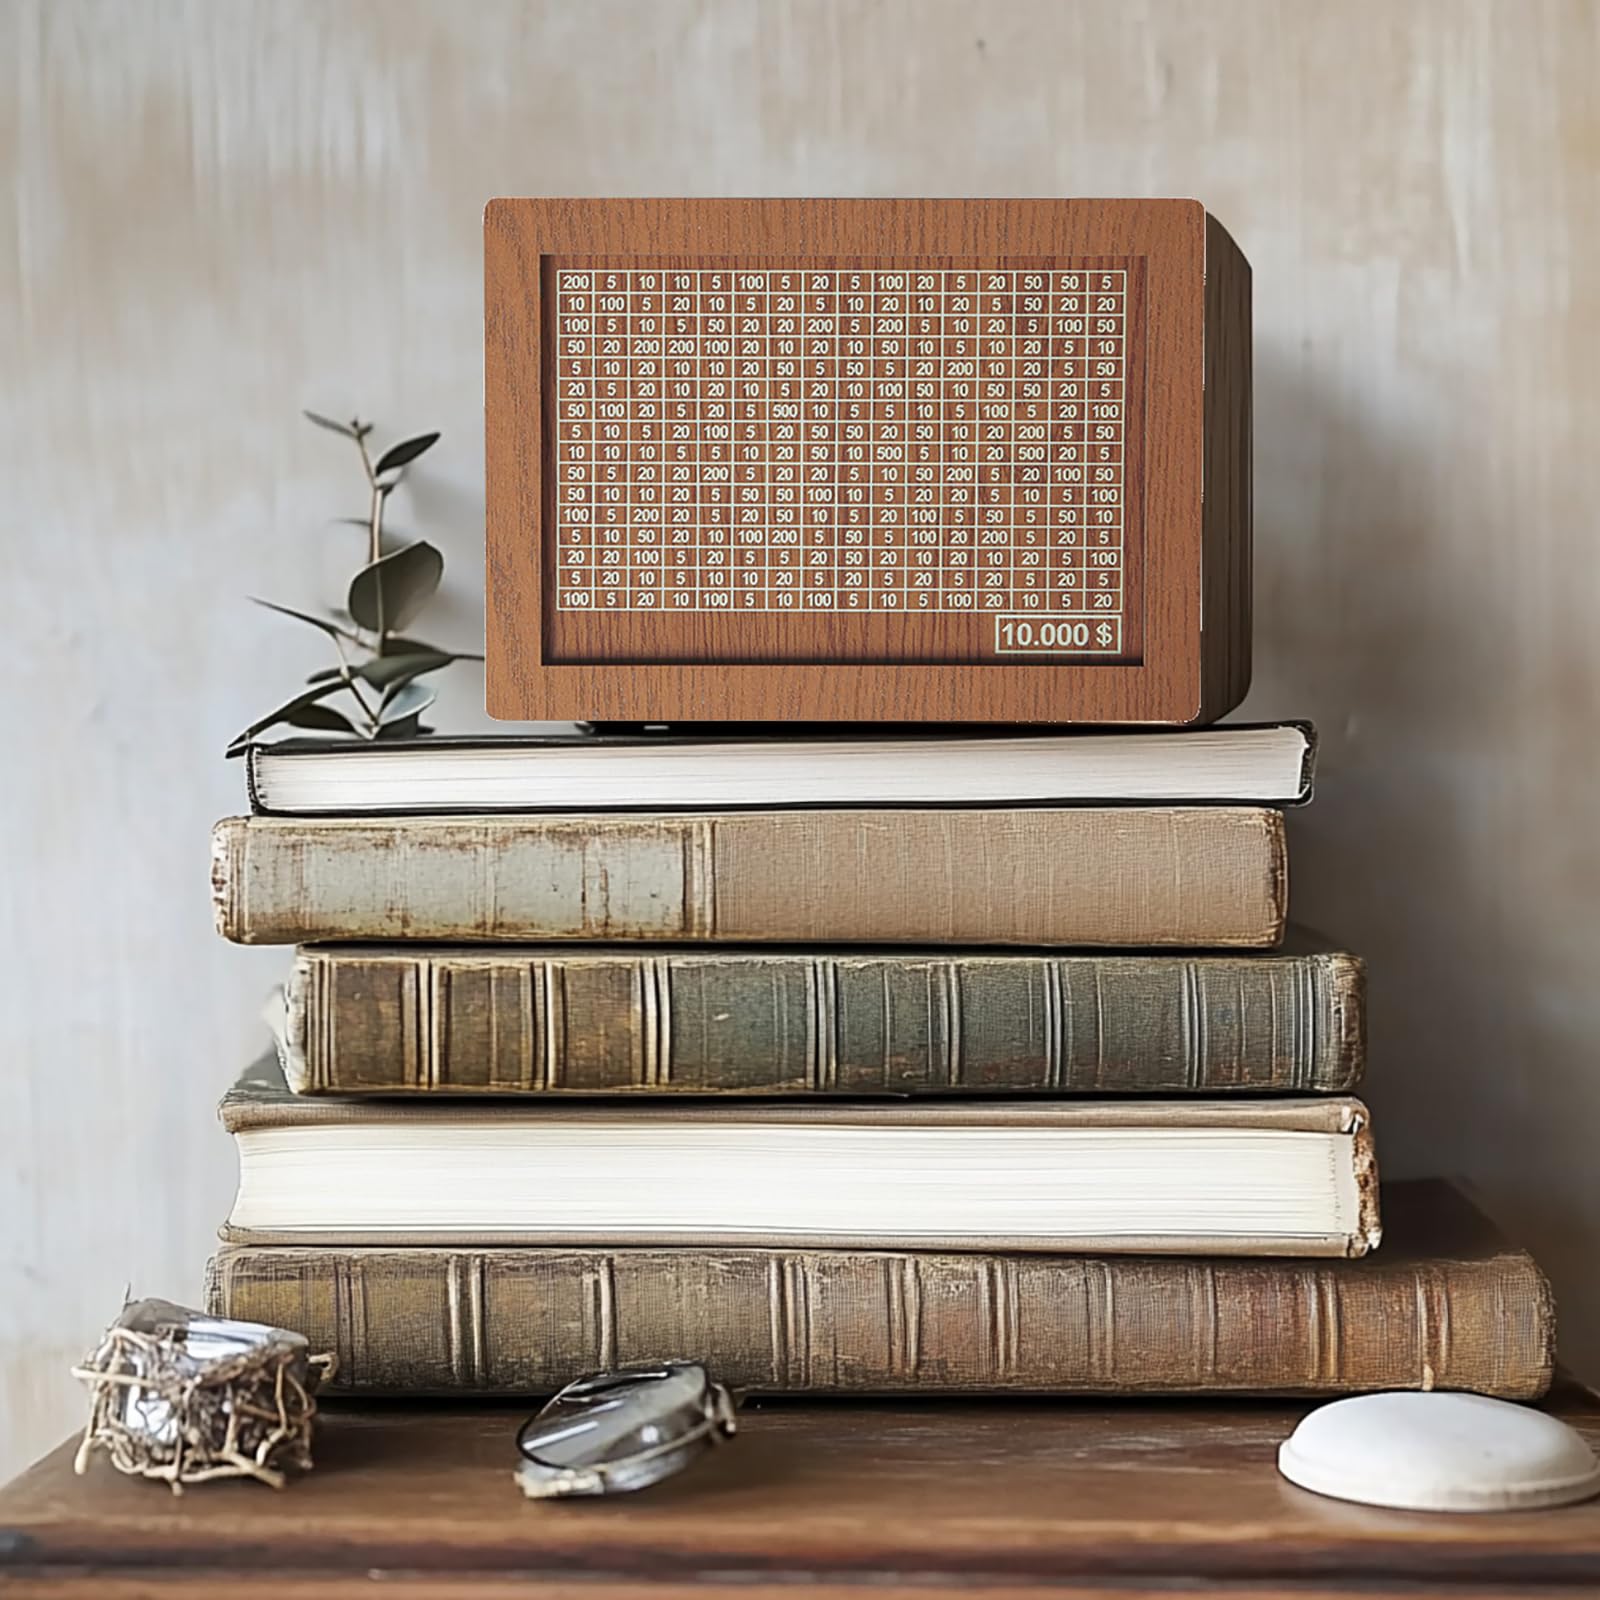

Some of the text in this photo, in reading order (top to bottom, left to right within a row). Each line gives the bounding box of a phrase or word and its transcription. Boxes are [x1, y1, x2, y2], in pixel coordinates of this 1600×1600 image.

[563, 275, 1111, 290] 200 5 10 10 5 100 5 20 5 100 20 5 20 50 50 5
[564, 318, 1115, 333] 100 5 10 5 50 20 20 200 5 200 5 10 20 5 100 50
[572, 361, 1115, 376] 5 10 20 10 10 20 50 5 50 5 20 200 10 20 5 50
[568, 403, 1119, 418] 50 100 20 5 20 5 500 10 5 5 10 5 100 5 20 100
[569, 446, 1109, 460] 10 10 10 5 5 10 20 50 10 500 5 10 20 500 20 5
[568, 487, 1117, 502] 50 10 10 20 5 50 50 100 10 5 20 20 5 10 5 100
[572, 529, 1109, 544] 5 10 50 20 10 100 200 5 50 5 100 20 200 5 20 5
[572, 571, 1108, 586] 5 20 10 5 10 10 20 5 20 5 20 5 20 5 20 5
[564, 592, 1112, 607] 100 5 20 10 100 5 10 100 5 10 5 100 20 10 5 20
[1001, 622, 1112, 647] 10.000 $
